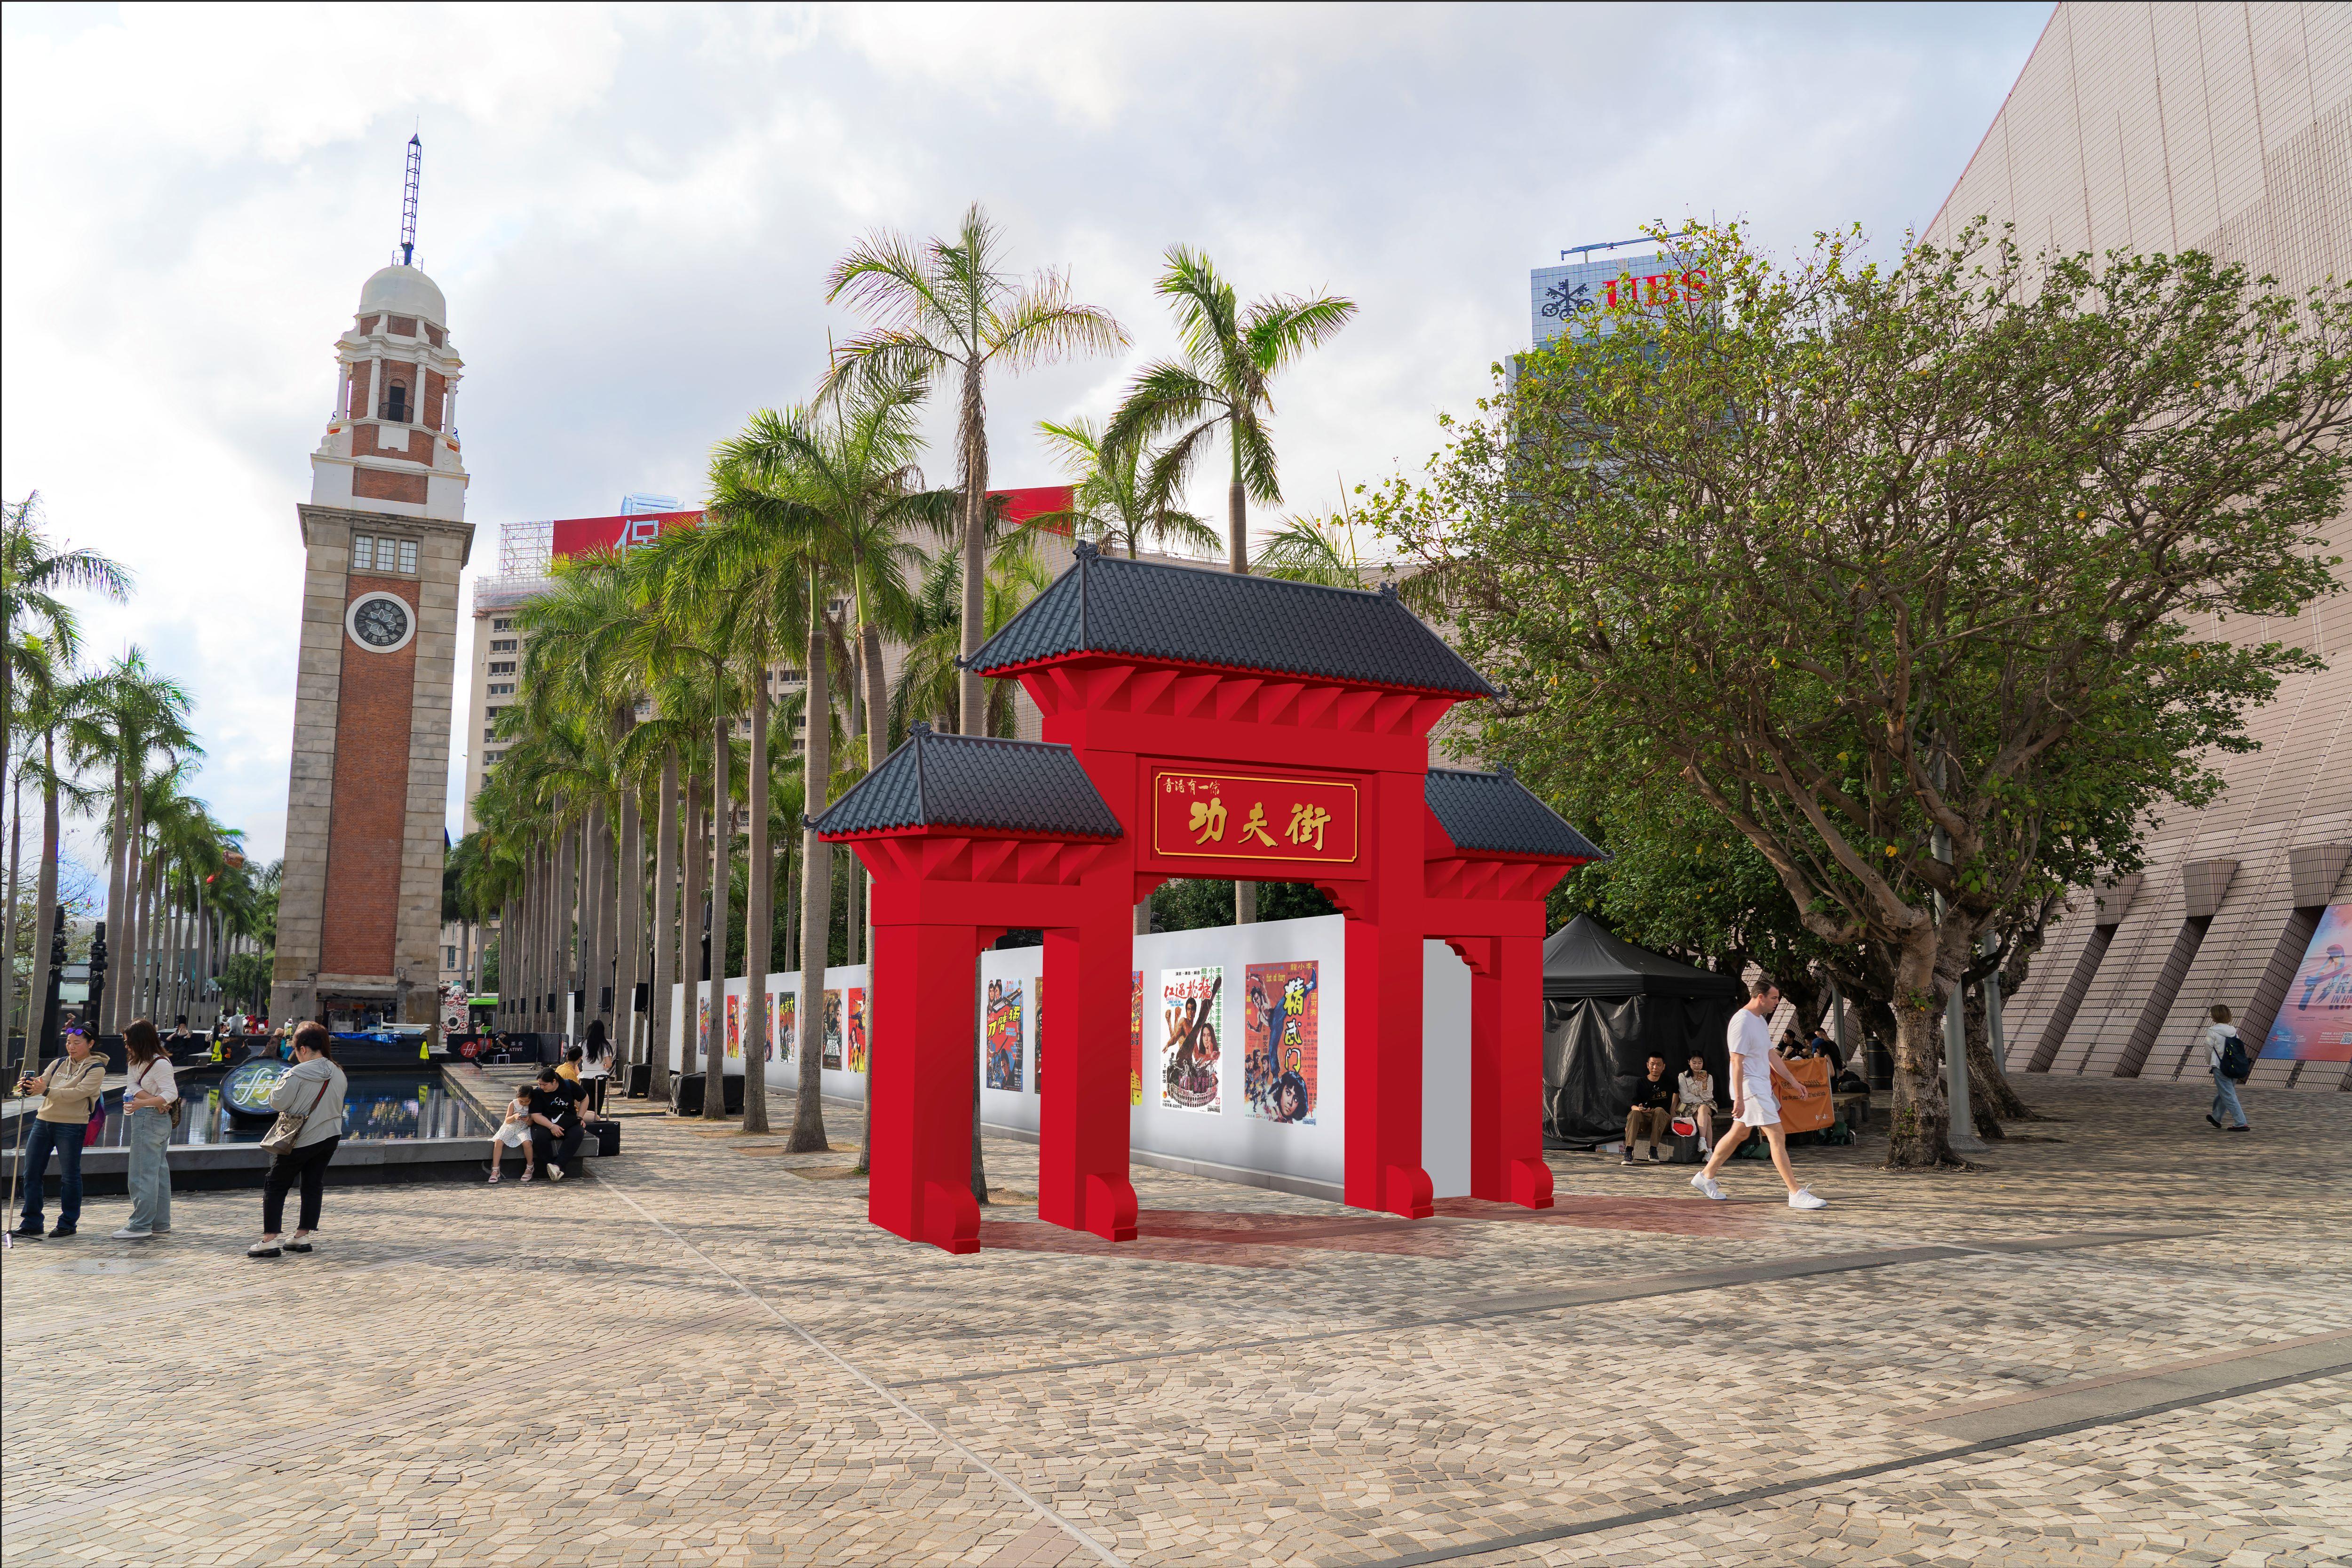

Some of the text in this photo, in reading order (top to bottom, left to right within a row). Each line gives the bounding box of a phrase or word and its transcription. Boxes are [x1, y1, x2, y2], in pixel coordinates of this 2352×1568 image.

[1602, 270, 1708, 308] UBS
[1163, 778, 1221, 796] 香港有一條
[1189, 797, 1331, 851] 功夫街
[2330, 995, 2342, 1003] IN
